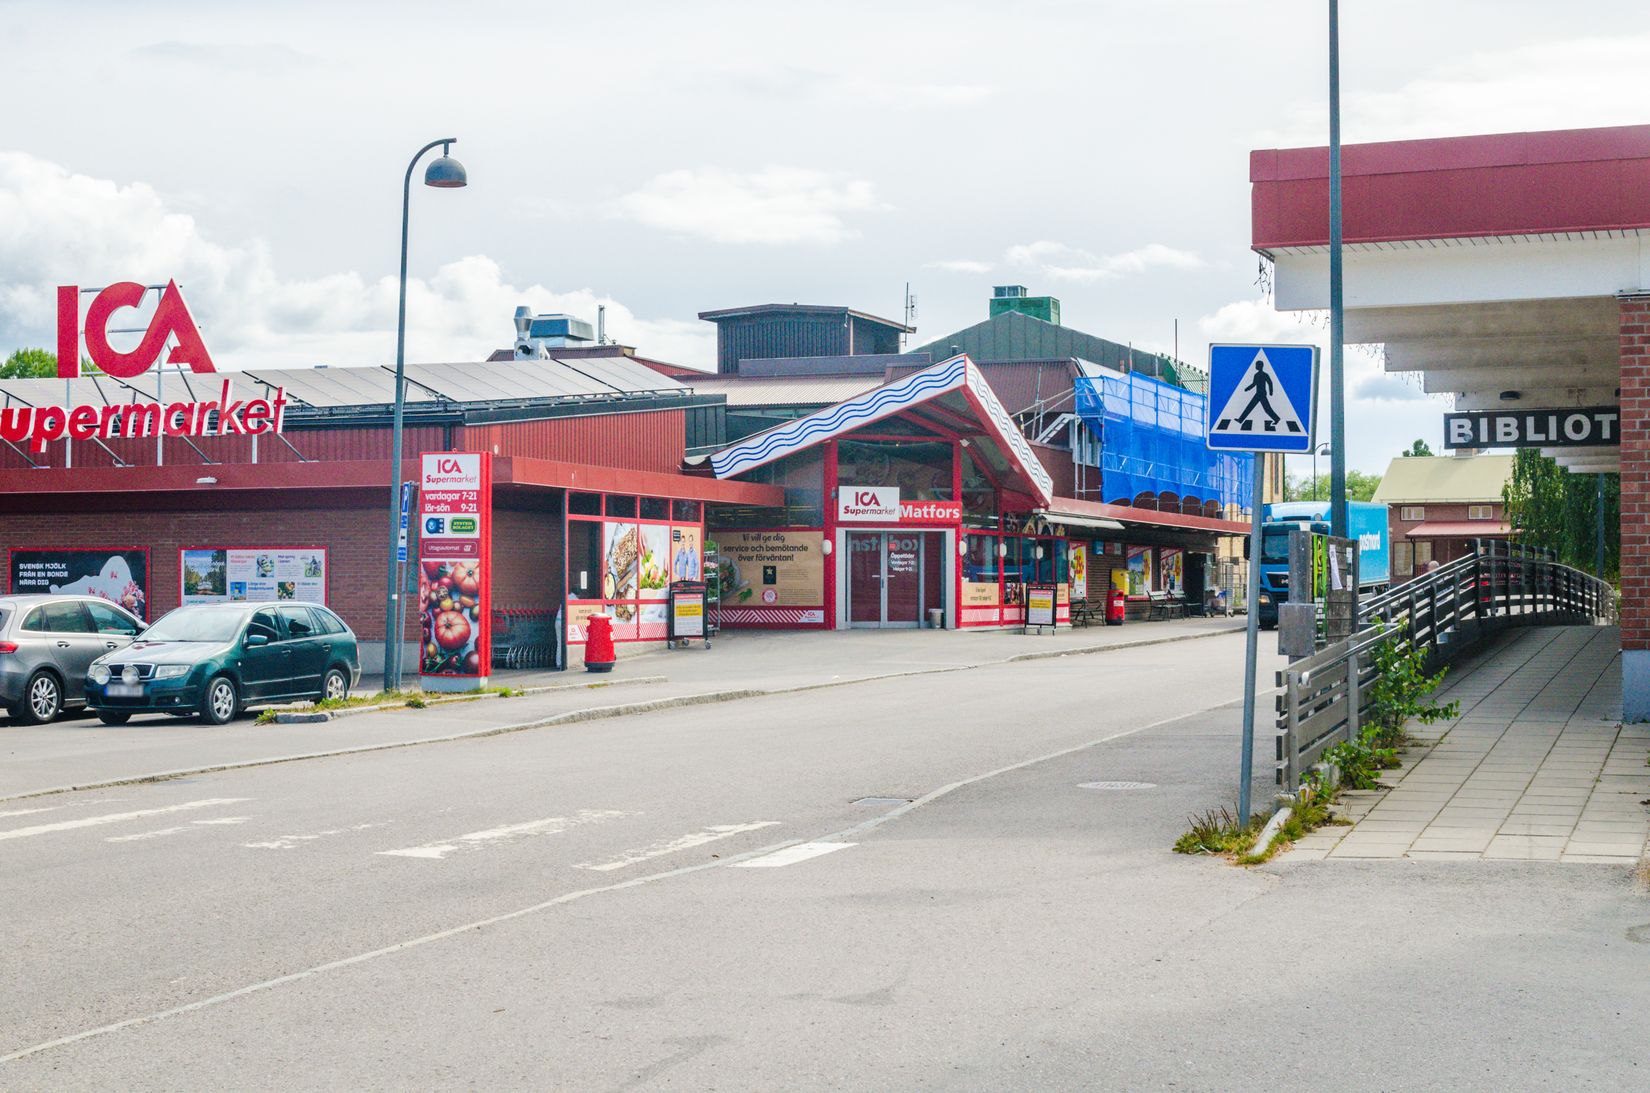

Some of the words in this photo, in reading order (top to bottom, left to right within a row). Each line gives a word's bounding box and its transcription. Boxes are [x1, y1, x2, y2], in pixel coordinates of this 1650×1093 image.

[57, 278, 217, 378] ICA
[1449, 413, 1618, 444] BIBLIOT
[437, 459, 462, 474] ICA
[426, 474, 477, 485] Supermarket
[425, 491, 460, 502] vardagar
[461, 491, 477, 500] 7-21
[855, 491, 881, 506] ICA
[425, 503, 450, 512] lör-sön
[461, 503, 477, 512] 9-21
[843, 505, 896, 516] Supermarket
[899, 504, 960, 519] Matfors
[773, 533, 785, 542] dig
[750, 544, 765, 552] och
[765, 544, 809, 552] bemötande
[19, 562, 44, 570] SVENSK
[45, 562, 67, 570] MJÖLK
[19, 570, 36, 578] FRÅN
